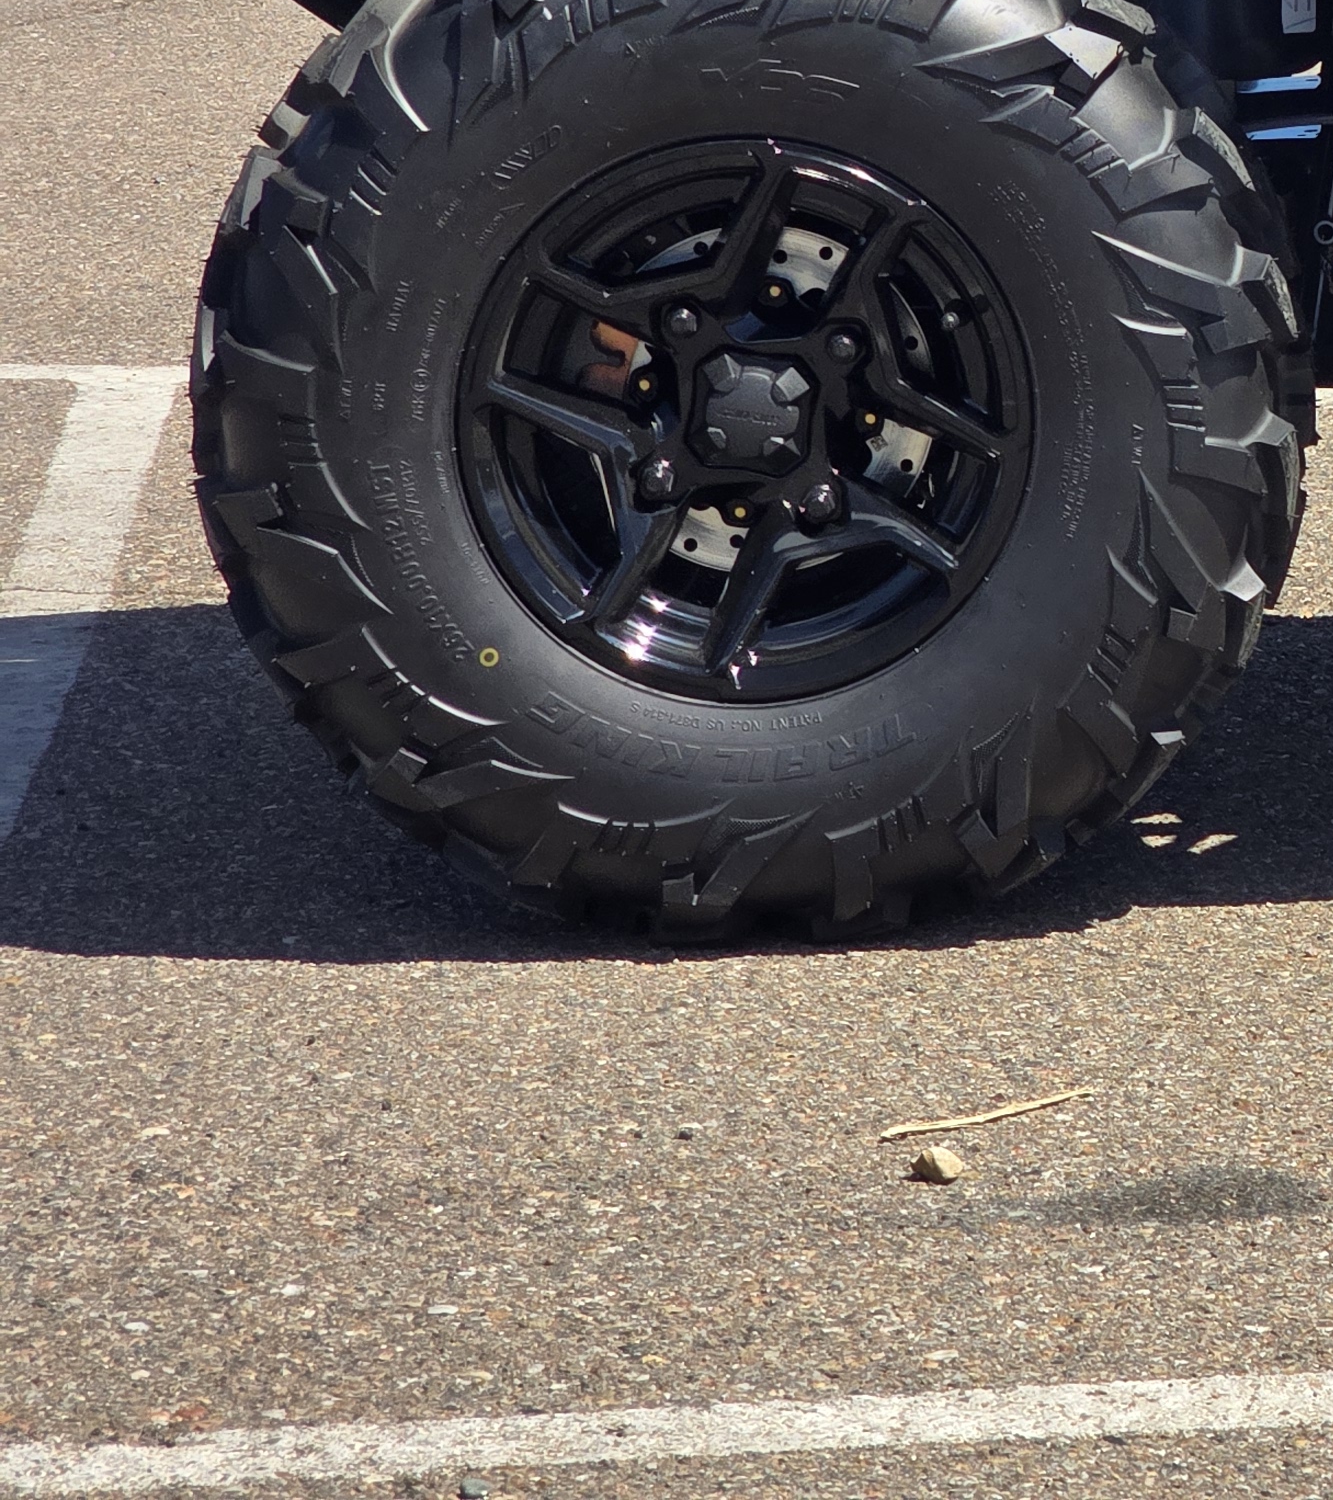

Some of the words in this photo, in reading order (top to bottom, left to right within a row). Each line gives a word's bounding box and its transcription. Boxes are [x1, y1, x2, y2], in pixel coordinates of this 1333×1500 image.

[523, 691, 703, 779] KING
[705, 718, 726, 732] US
[768, 710, 823, 732] PATENT
[714, 712, 918, 784] TRAIL
